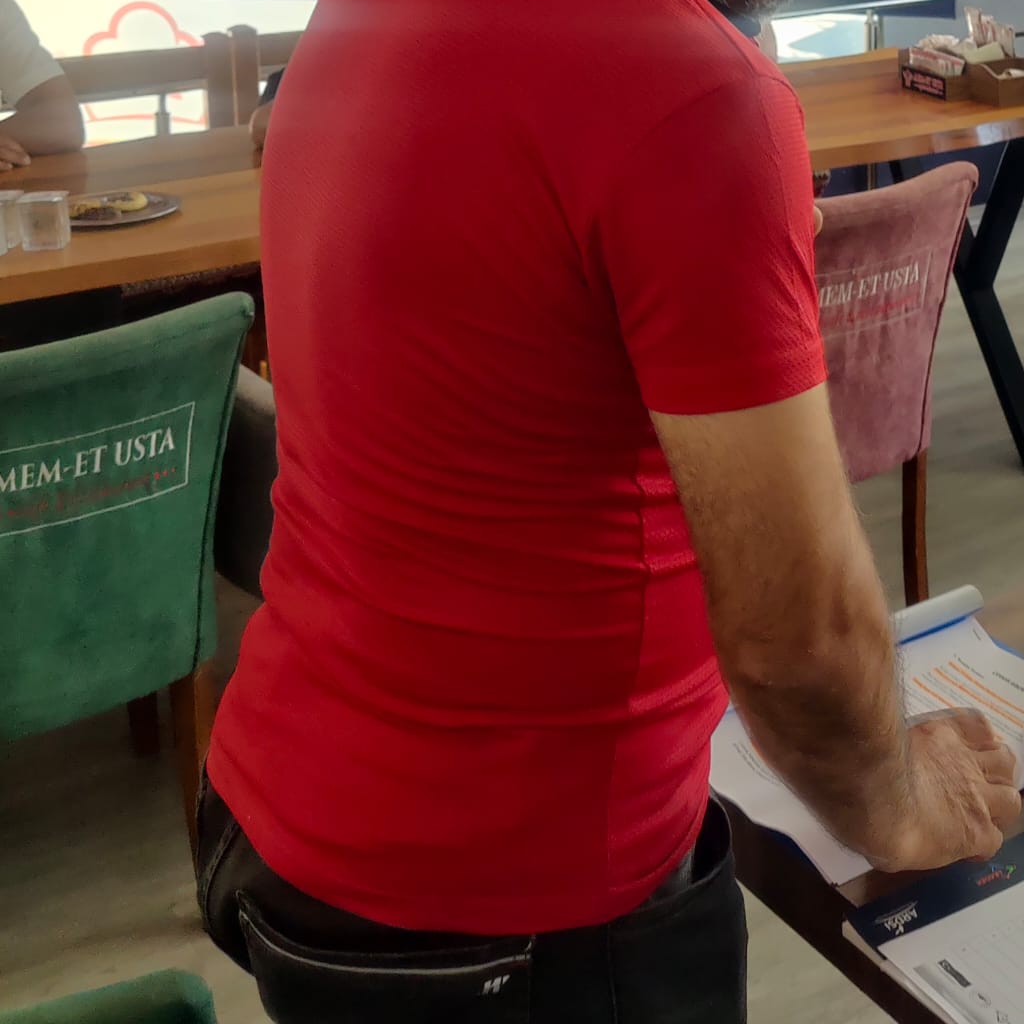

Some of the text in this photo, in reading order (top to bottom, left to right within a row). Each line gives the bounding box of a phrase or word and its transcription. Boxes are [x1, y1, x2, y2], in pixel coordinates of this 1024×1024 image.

[883, 261, 919, 291] USTA
[0, 426, 176, 493] MEM-ET USTA
